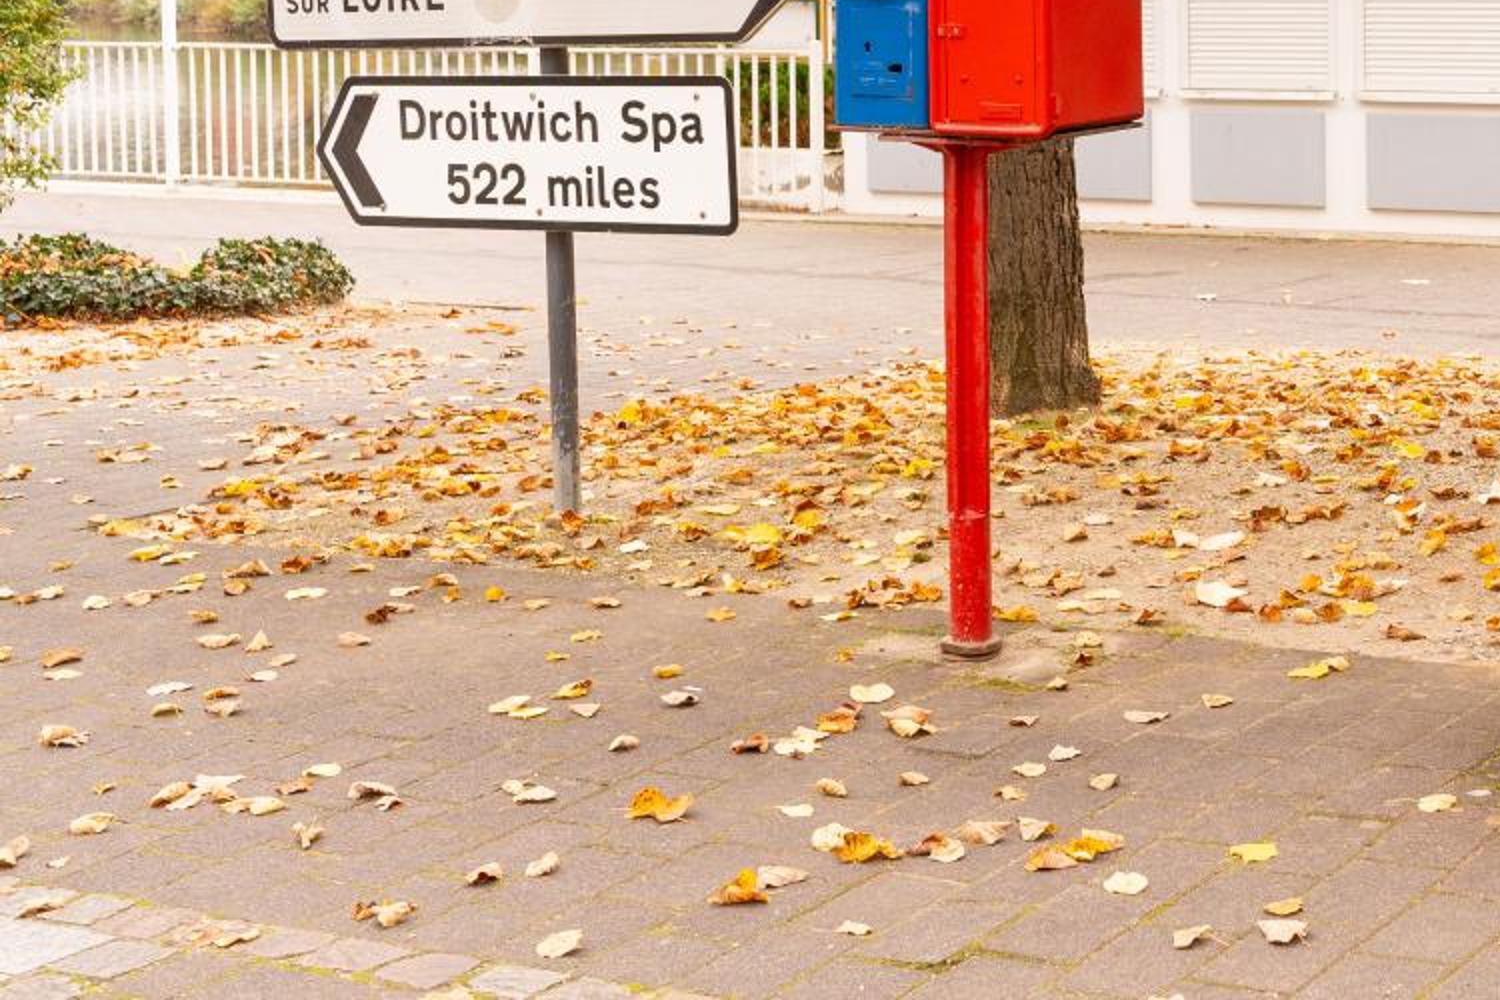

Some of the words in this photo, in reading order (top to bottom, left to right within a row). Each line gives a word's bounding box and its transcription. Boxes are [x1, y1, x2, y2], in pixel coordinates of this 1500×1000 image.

[399, 99, 599, 143] Droitwich
[621, 100, 704, 153] Spa
[447, 162, 527, 205] 522
[547, 165, 660, 209] miles
